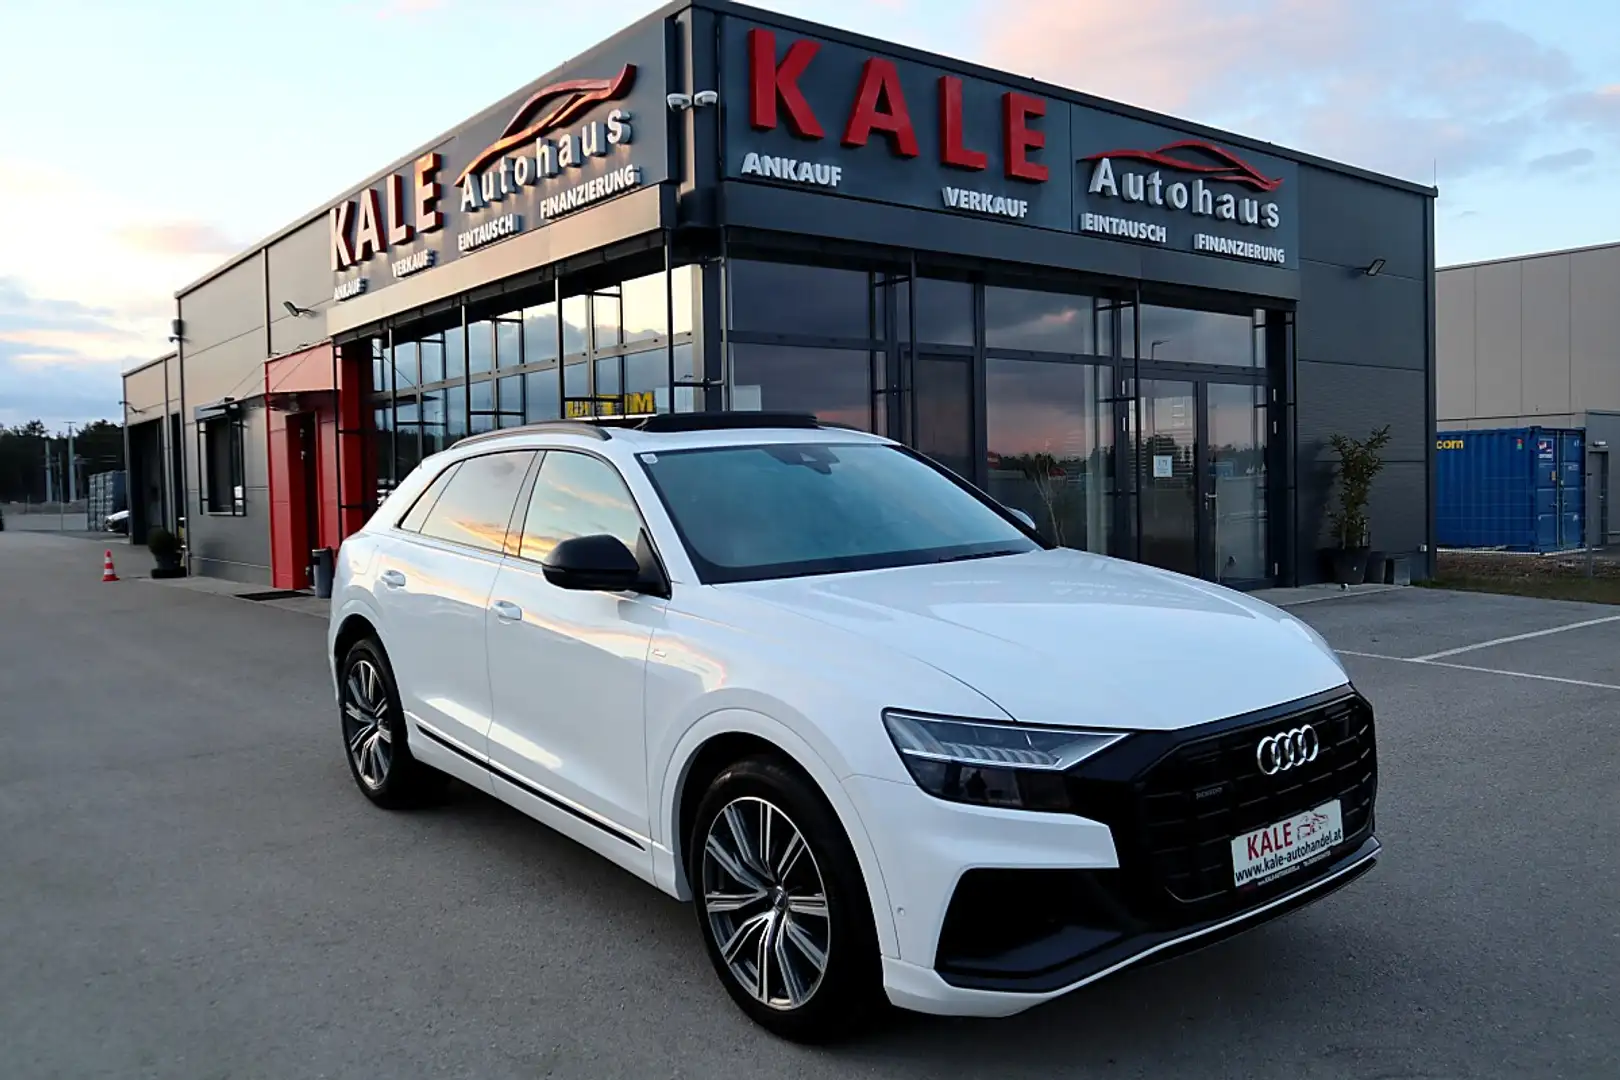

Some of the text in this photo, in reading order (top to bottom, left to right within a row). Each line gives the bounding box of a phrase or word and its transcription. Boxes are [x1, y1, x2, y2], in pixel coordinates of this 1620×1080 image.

[747, 27, 1281, 229] KALE Autohaus
[329, 108, 632, 272] KALE Autohaus
[392, 248, 435, 279] VERKAUF
[457, 213, 516, 252] EINTAUSCH
[540, 165, 640, 220] FINANZIERUNG
[741, 152, 1286, 264] ANKAUF VERKAUF EINTAUSCH FINANZIERUNG
[1235, 828, 1343, 882] www.kale-autohandel.at
[1247, 822, 1293, 861] KALE
